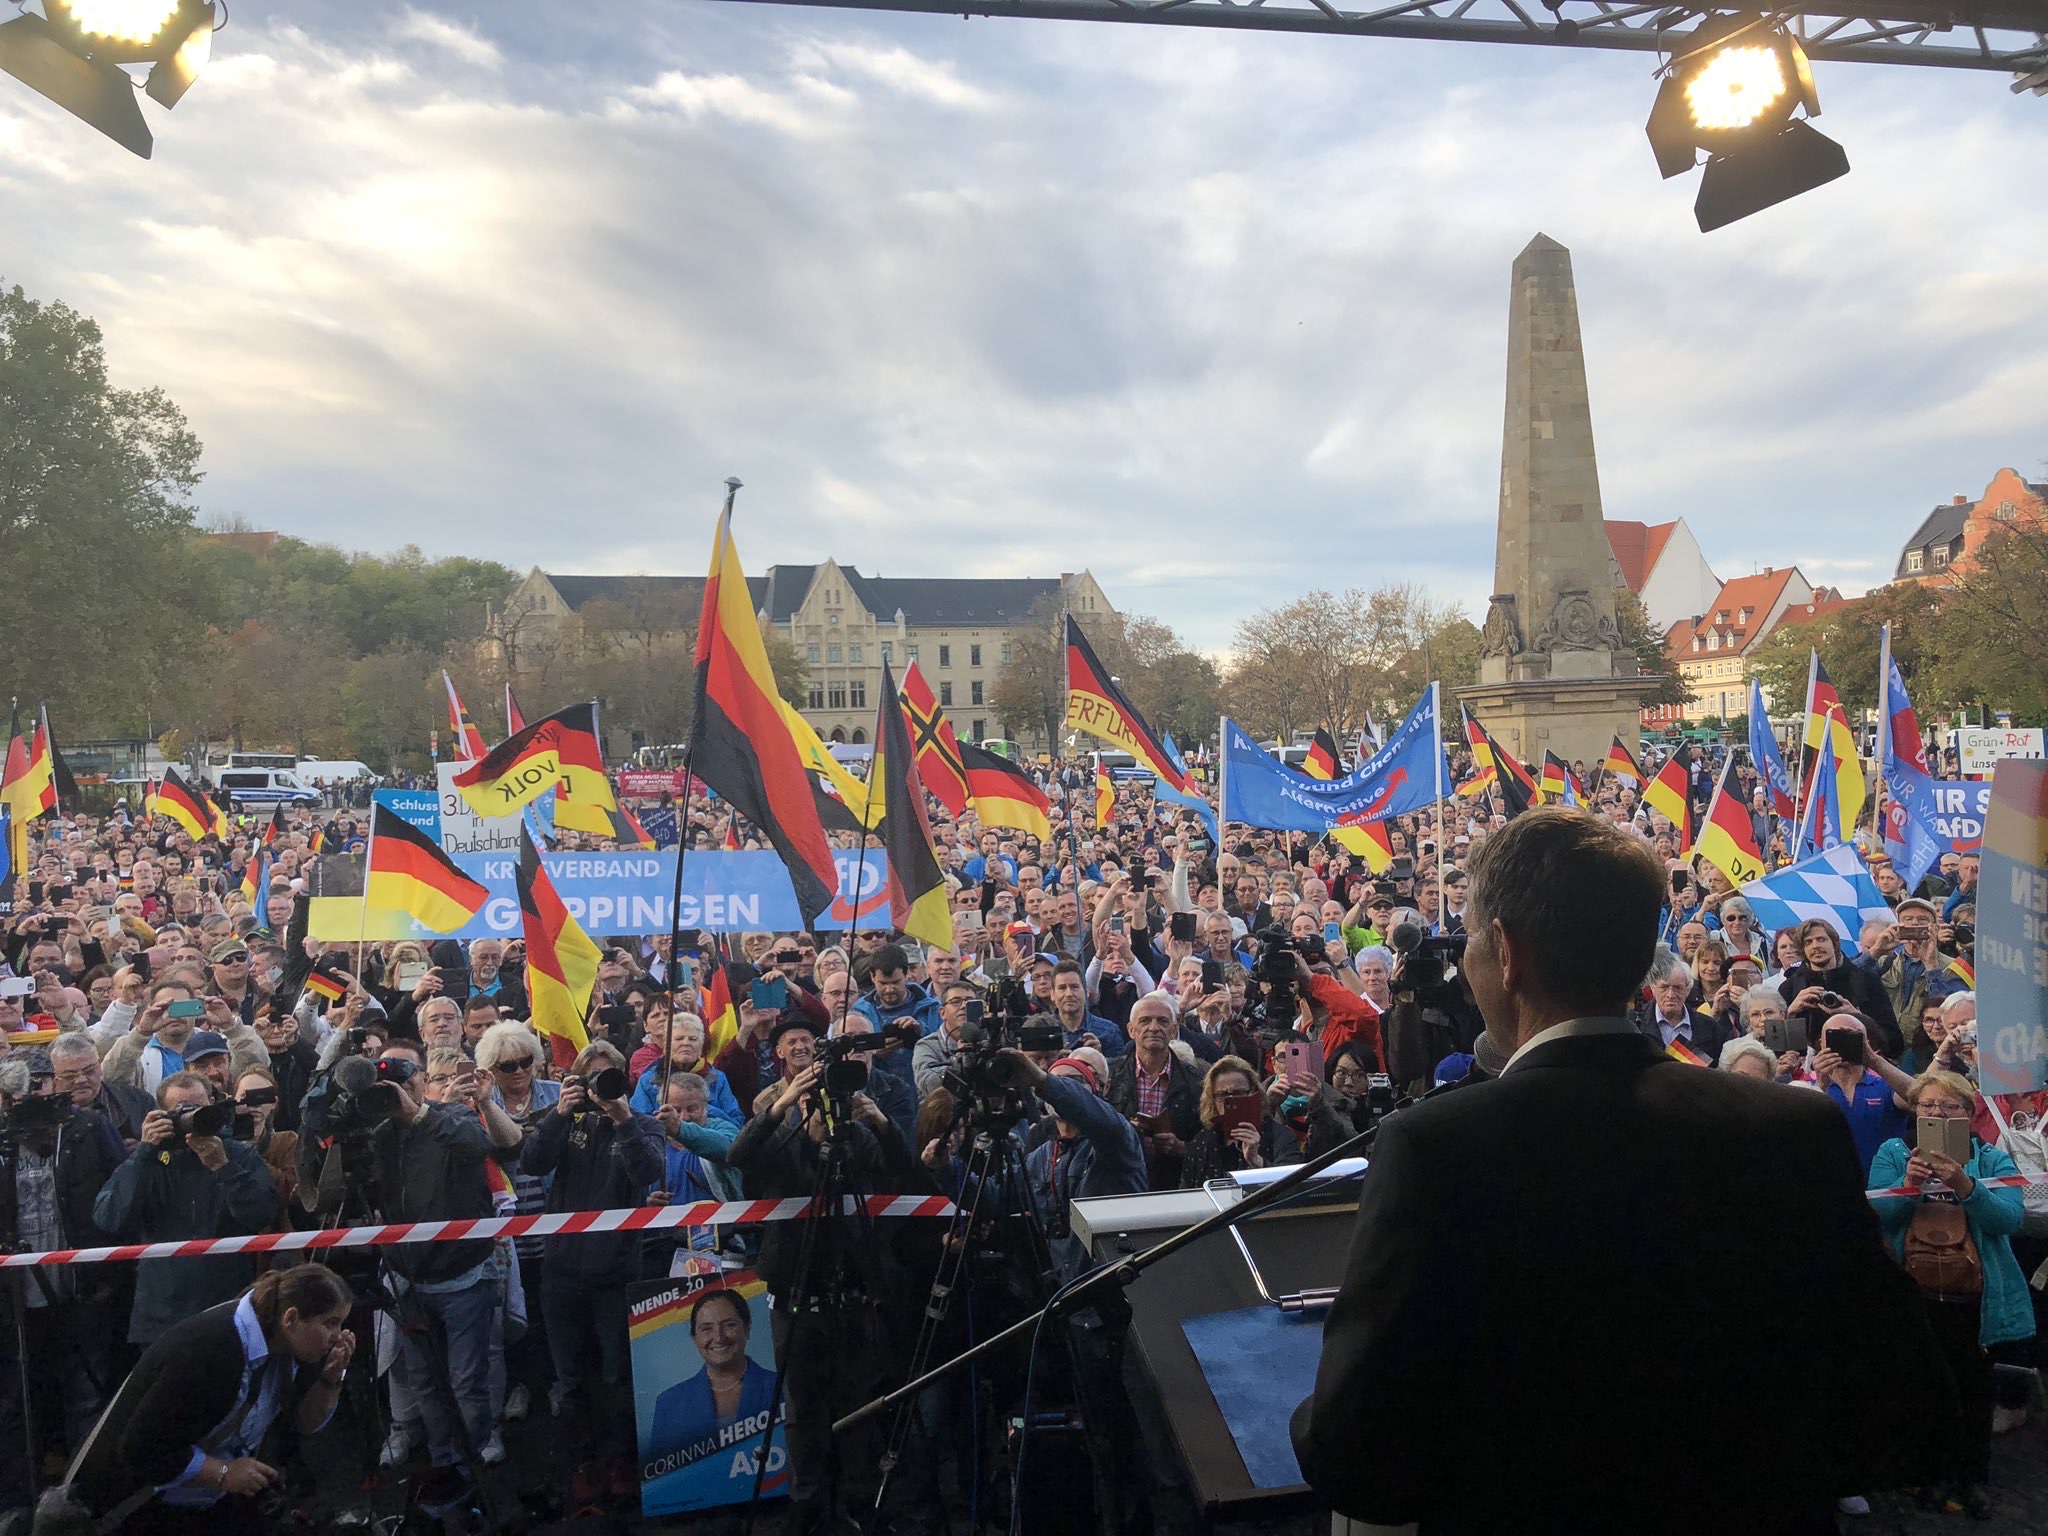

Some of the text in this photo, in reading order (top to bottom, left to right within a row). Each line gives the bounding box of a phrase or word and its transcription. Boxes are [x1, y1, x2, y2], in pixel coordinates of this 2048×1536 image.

[1360, 705, 1433, 779] Chemitz
[2005, 733, 2031, 747] Rot
[392, 798, 438, 811] Schluss
[1280, 786, 1385, 814] Alternative
[1932, 789, 1967, 814] IR
[1937, 816, 1982, 838] AfD
[485, 859, 660, 880] KRVERBAND
[835, 857, 880, 896] fD
[485, 894, 760, 931] GPPINGEN
[644, 1437, 717, 1480] CORINNA
